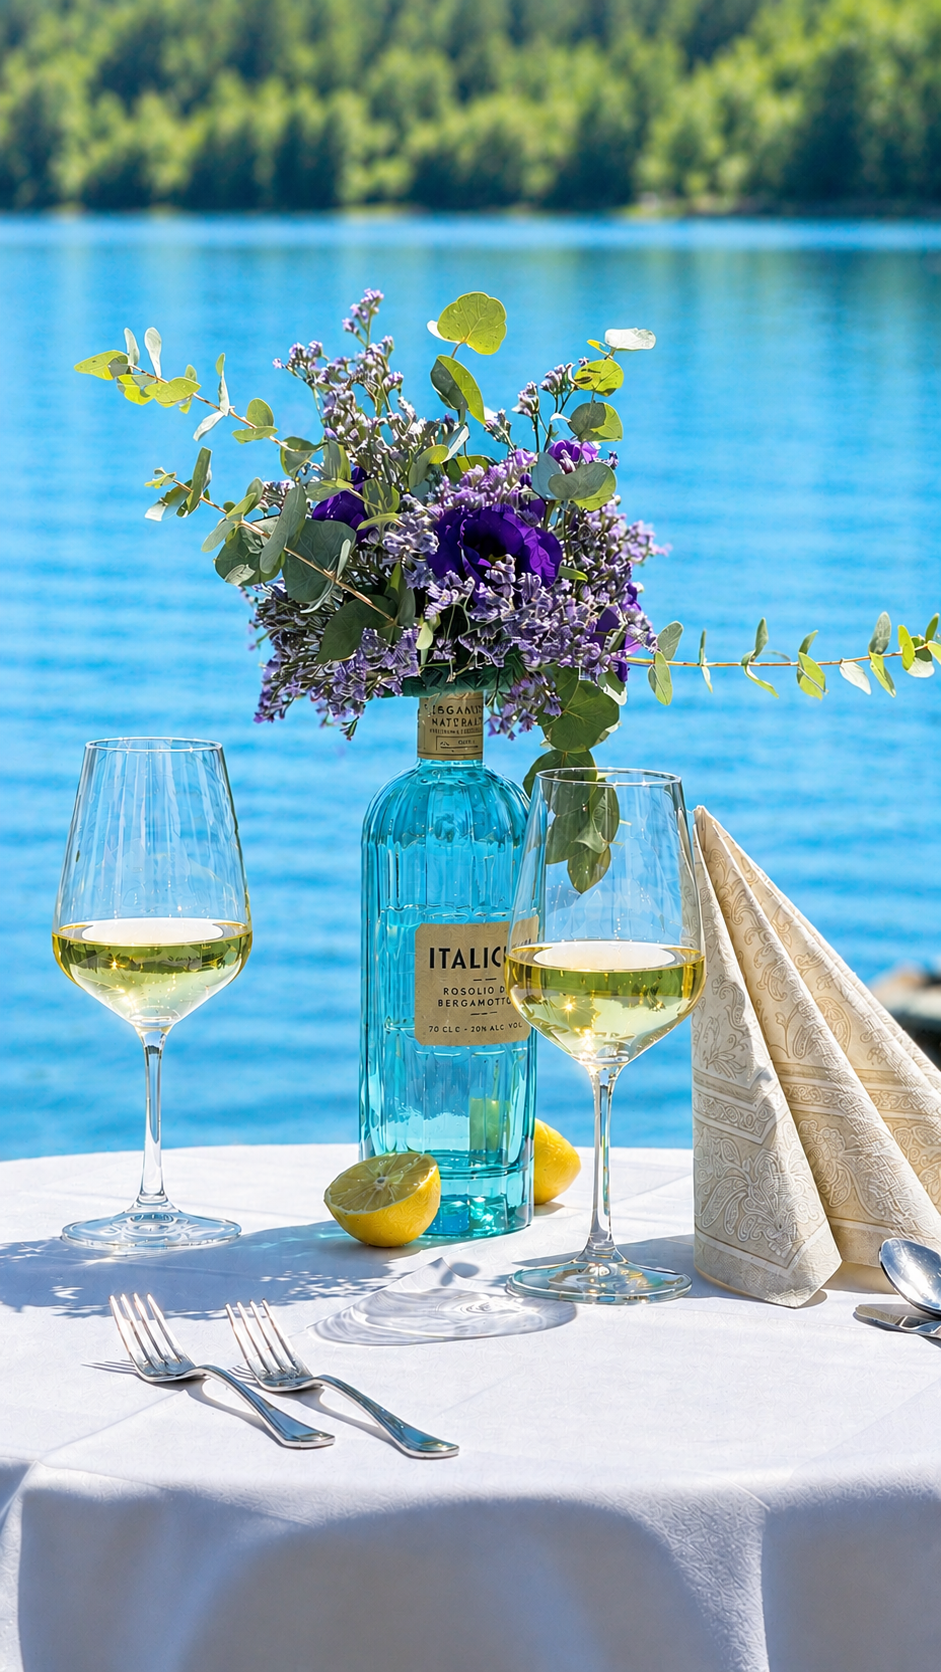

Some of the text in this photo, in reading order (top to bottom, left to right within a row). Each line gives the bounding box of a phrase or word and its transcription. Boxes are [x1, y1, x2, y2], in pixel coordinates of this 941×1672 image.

[443, 986, 494, 996] ROSOLIO
[428, 1025, 439, 1033] 70
[489, 1024, 505, 1032] ALC
